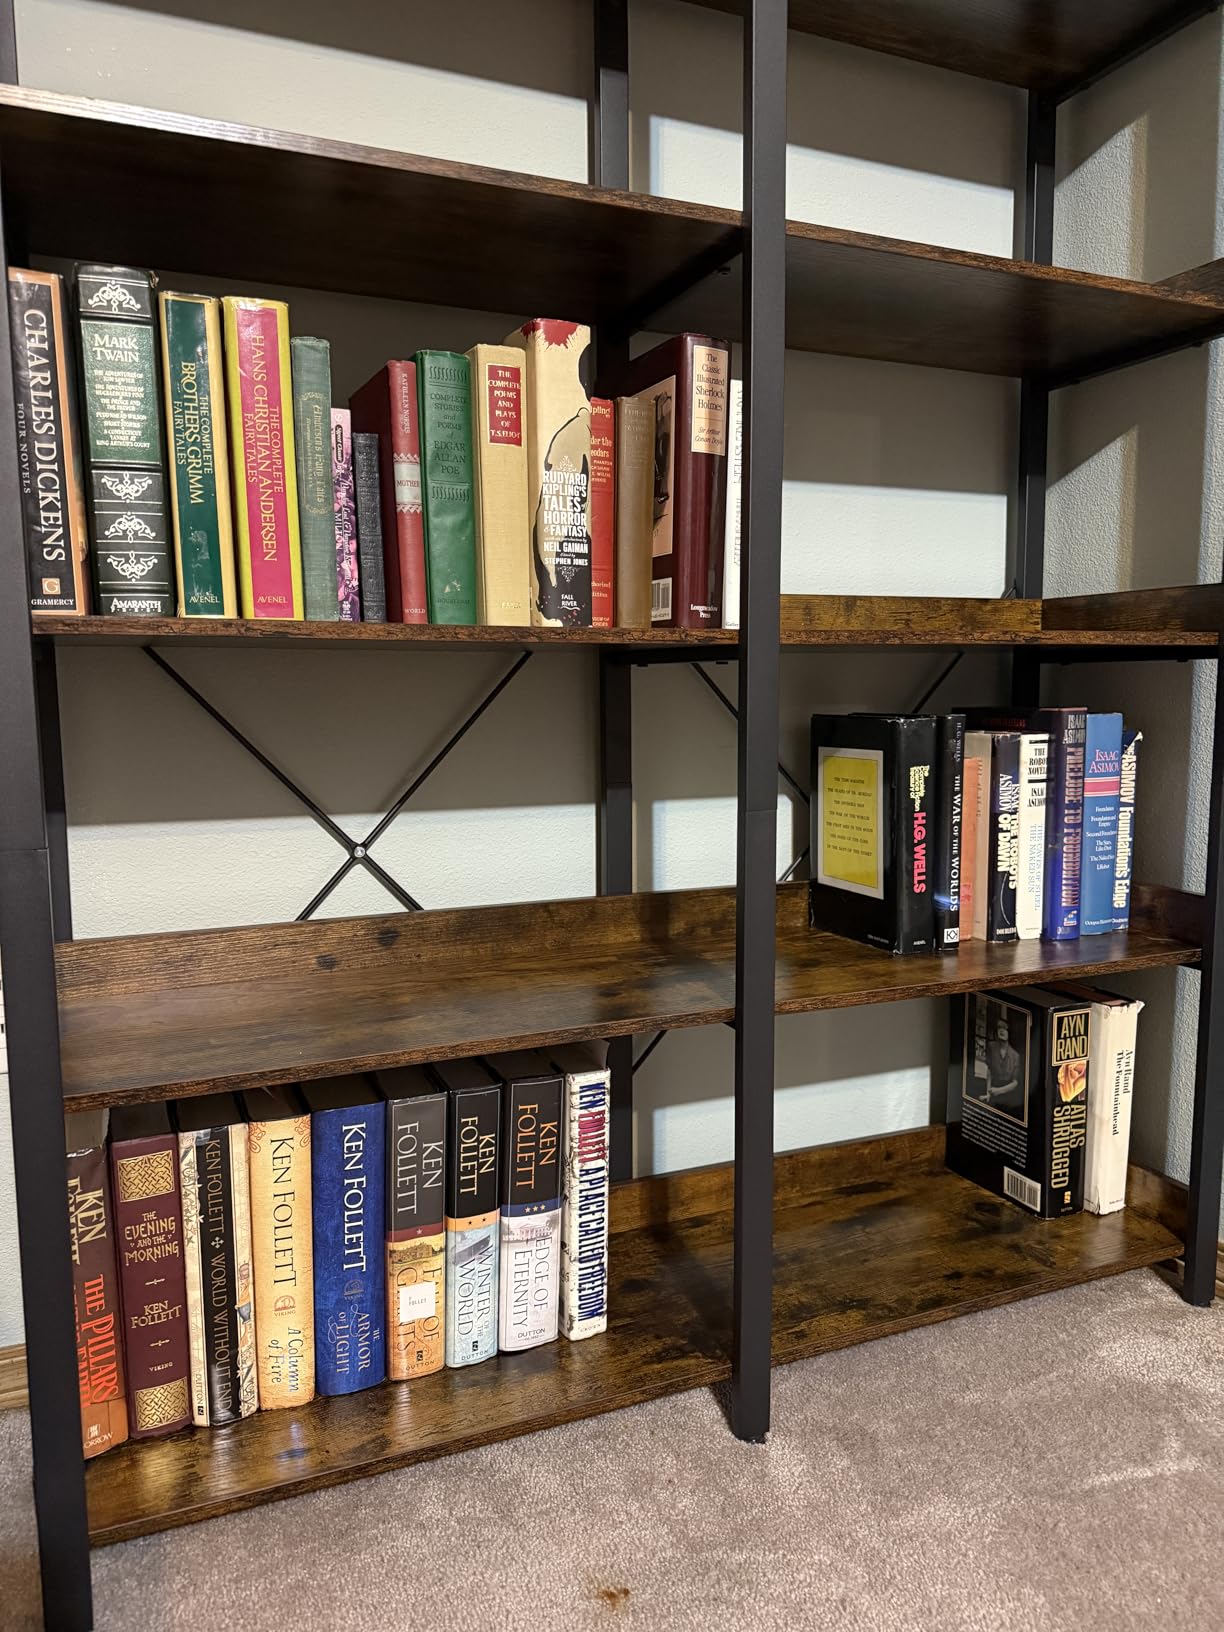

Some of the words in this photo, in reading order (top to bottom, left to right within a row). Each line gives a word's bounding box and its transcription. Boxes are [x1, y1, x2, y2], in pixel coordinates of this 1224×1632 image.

[93, 347, 140, 362] TWAIN
[94, 334, 139, 350] MARK
[23, 308, 56, 436] CHARLES
[252, 335, 267, 381] HANS
[702, 363, 721, 375] Classic
[706, 353, 718, 363] The
[488, 379, 520, 389] COMPLETE
[497, 370, 512, 378] THE
[696, 374, 725, 385] Illustrated
[181, 362, 200, 443] BROTHERS
[200, 395, 209, 417] THE
[494, 390, 517, 399] POEMS
[497, 400, 513, 408] AND
[696, 385, 725, 399] Sherlock
[698, 398, 722, 411] Holmes
[16, 403, 26, 438] FOUR
[174, 401, 185, 429] FAIRY
[270, 407, 280, 433] THE
[434, 402, 464, 413] STORIES
[495, 410, 517, 418] PLAYS
[245, 413, 255, 446] FAIRY
[254, 384, 272, 472] CHRISTIAN
[437, 421, 462, 431] POEMS
[176, 433, 187, 465] TALES
[201, 418, 213, 474] COMPLETE
[434, 440, 465, 452] EDGAR
[434, 452, 466, 464] ALLAN
[20, 443, 31, 494] NOVELS
[186, 446, 205, 504] GRIMM
[247, 447, 258, 483] TALES
[271, 435, 283, 493] COMPLETE
[441, 465, 460, 475] POE
[542, 470, 587, 486] RUDYARD
[34, 440, 66, 562] DICKENS
[542, 483, 587, 497] KIPLING'S
[543, 495, 582, 513] TALES
[258, 475, 277, 561] ANDERSEN
[334, 513, 343, 550] MILTON
[543, 511, 587, 526] HORROR
[550, 525, 587, 538] FANTASY
[543, 541, 562, 552] NEIL
[562, 542, 589, 554] GAIMAN
[573, 558, 589, 566] JONES
[110, 597, 161, 608] AMARANTH
[189, 595, 220, 603] AVENEL
[258, 595, 288, 603] AVENEL
[1034, 748, 1046, 756] THE
[1095, 749, 1118, 762] ISAAC
[1064, 747, 1084, 804] PRELUDE
[1120, 755, 1136, 804] ASIMOV
[952, 793, 962, 824] WAR
[999, 773, 1013, 814] ASIMOV
[1011, 783, 1020, 813] ISAAC
[913, 812, 926, 844] H.G.
[998, 813, 1012, 831] OF
[1010, 813, 1020, 839] THE
[1063, 806, 1082, 824] TO
[997, 832, 1011, 872] DAWN
[1115, 806, 1134, 878] Foundation's
[913, 843, 926, 894] WELLS
[1008, 839, 1019, 889] ROBOTS
[1028, 844, 1036, 874] NAKED
[1061, 828, 1081, 907] FOUNDATION
[949, 857, 960, 912] WORLDS
[1113, 879, 1130, 908] Edge
[1060, 1014, 1085, 1038] AYN
[1056, 1035, 1087, 1061] RAND
[1125, 1049, 1133, 1067] Ayn
[579, 1081, 606, 1110] KEN
[1122, 1069, 1132, 1094] Rand
[1112, 1069, 1123, 1136] Fountainhead
[577, 1109, 607, 1164] FOLLETT
[1069, 1104, 1087, 1149] ATLAS
[205, 1139, 222, 1170] KEN
[342, 1121, 366, 1171] KEN
[460, 1116, 478, 1196] FOLLETT
[479, 1133, 495, 1174] KEN
[516, 1103, 538, 1189] FOLLETT
[539, 1121, 558, 1166] KEN
[1050, 1105, 1071, 1189] SHRUGGED
[270, 1137, 295, 1184] KEN
[397, 1120, 419, 1215] FOLLETT
[422, 1140, 443, 1189] KEN
[578, 1166, 605, 1178] A
[206, 1173, 224, 1233] FOLLETT
[578, 1176, 605, 1219] PLACE
[75, 1187, 107, 1244] KEN
[124, 1216, 176, 1241] EVENING
[142, 1210, 157, 1221] THE
[343, 1175, 367, 1272] FOLLETT
[136, 1236, 152, 1248] AND
[152, 1235, 167, 1245] THE
[273, 1190, 297, 1287] FOLLETT
[578, 1217, 605, 1264] CALLED
[124, 1241, 180, 1267] MORNING
[534, 1236, 552, 1284] EDGE
[84, 1273, 106, 1316] THE
[210, 1252, 228, 1307] WORLD
[477, 1243, 493, 1321] WINTER
[513, 1249, 533, 1327] ETERNITY
[577, 1261, 606, 1322] FREEDOM
[143, 1300, 169, 1316] KEN
[458, 1258, 476, 1335] WORLD
[533, 1288, 549, 1310] OF
[130, 1304, 182, 1329] FOLLETT
[274, 1309, 296, 1317] VIKING
[338, 1311, 347, 1322] OF
[213, 1309, 231, 1379] WITHOUT
[268, 1339, 283, 1349] of
[288, 1327, 301, 1335] A
[356, 1309, 371, 1372] ARMOR
[422, 1315, 440, 1343] OF
[517, 1327, 546, 1339] DUTTON
[80, 1311, 119, 1403] PILLARS
[336, 1322, 350, 1374] LIGHT
[461, 1349, 488, 1361] DUTTON
[149, 1361, 173, 1372] VIKING
[269, 1353, 285, 1383] Fire
[288, 1338, 304, 1392] Column
[405, 1359, 435, 1371] DUTTON
[195, 1374, 204, 1405] DUTTON
[216, 1382, 233, 1411] END
